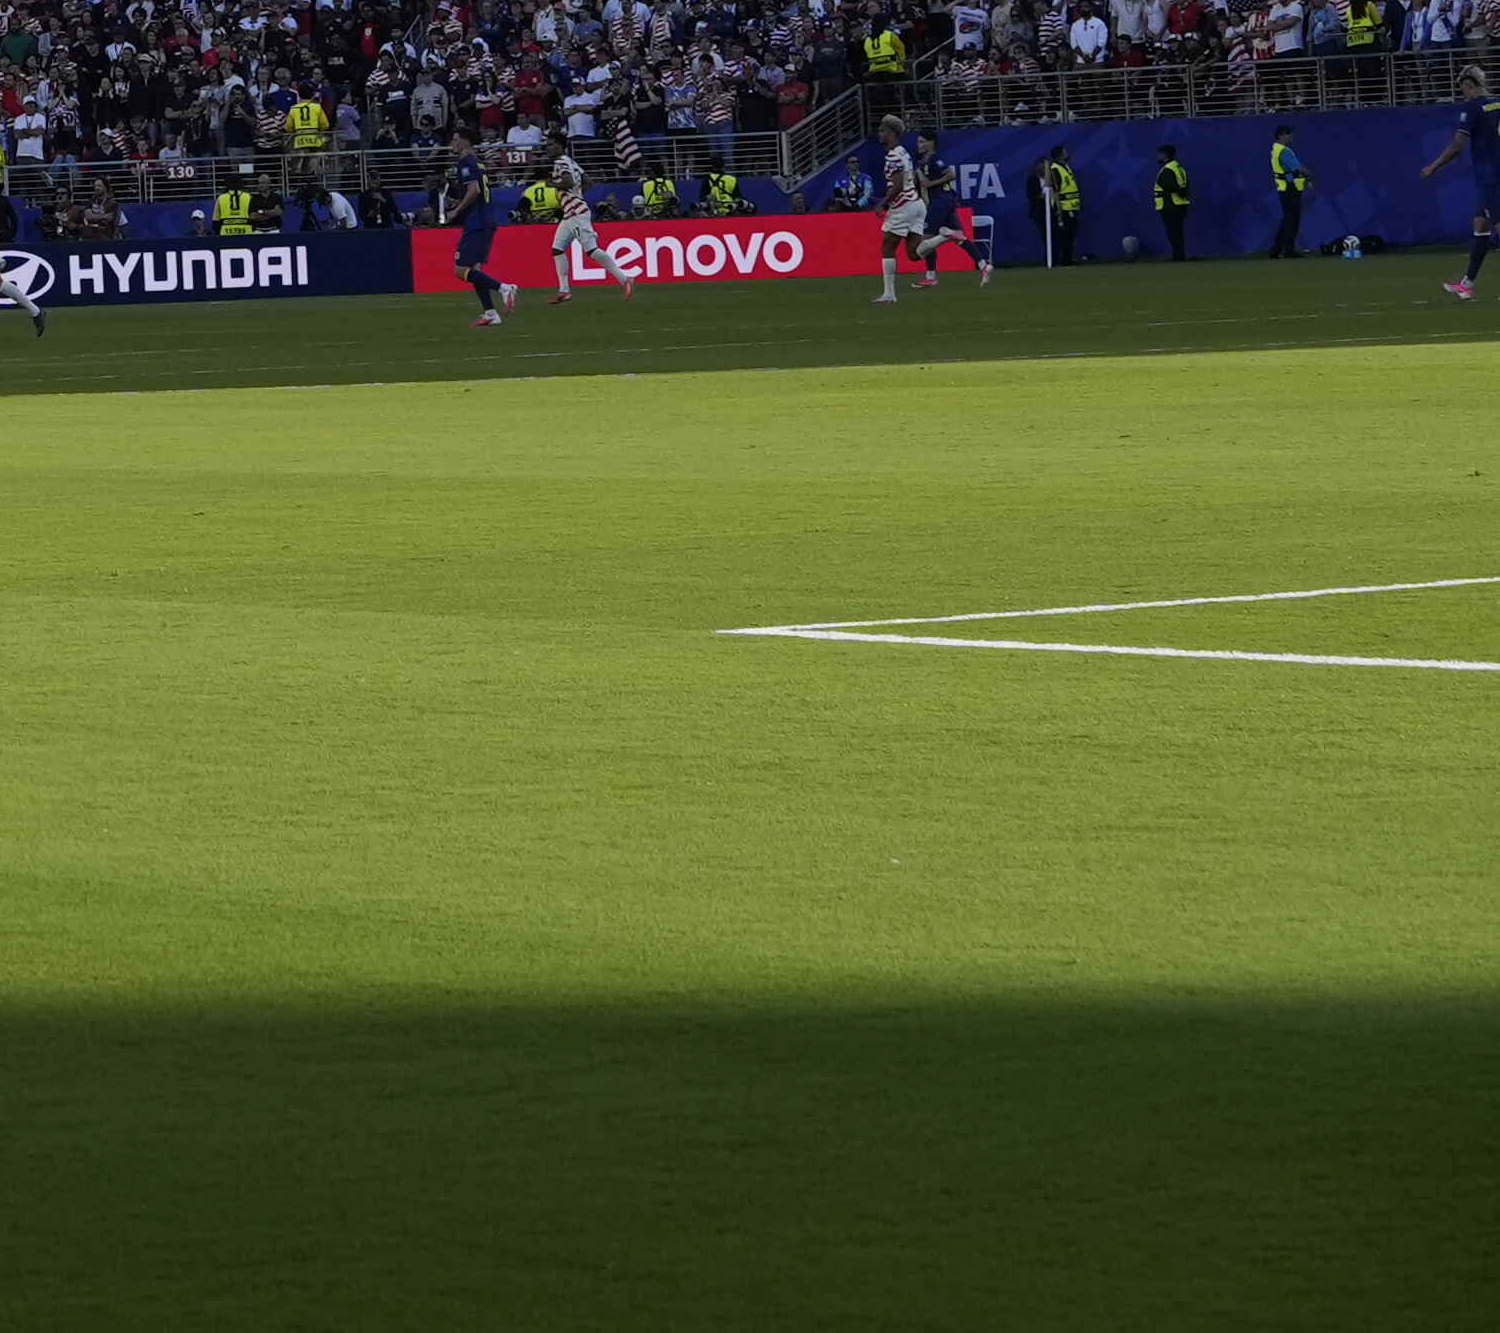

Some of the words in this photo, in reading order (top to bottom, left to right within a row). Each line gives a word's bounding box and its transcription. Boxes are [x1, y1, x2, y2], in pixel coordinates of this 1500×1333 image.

[167, 166, 195, 180] 130
[506, 151, 527, 164] 131
[952, 163, 1006, 200] FA
[69, 245, 309, 295] HYUNDAI
[569, 231, 805, 283] Lenovo
